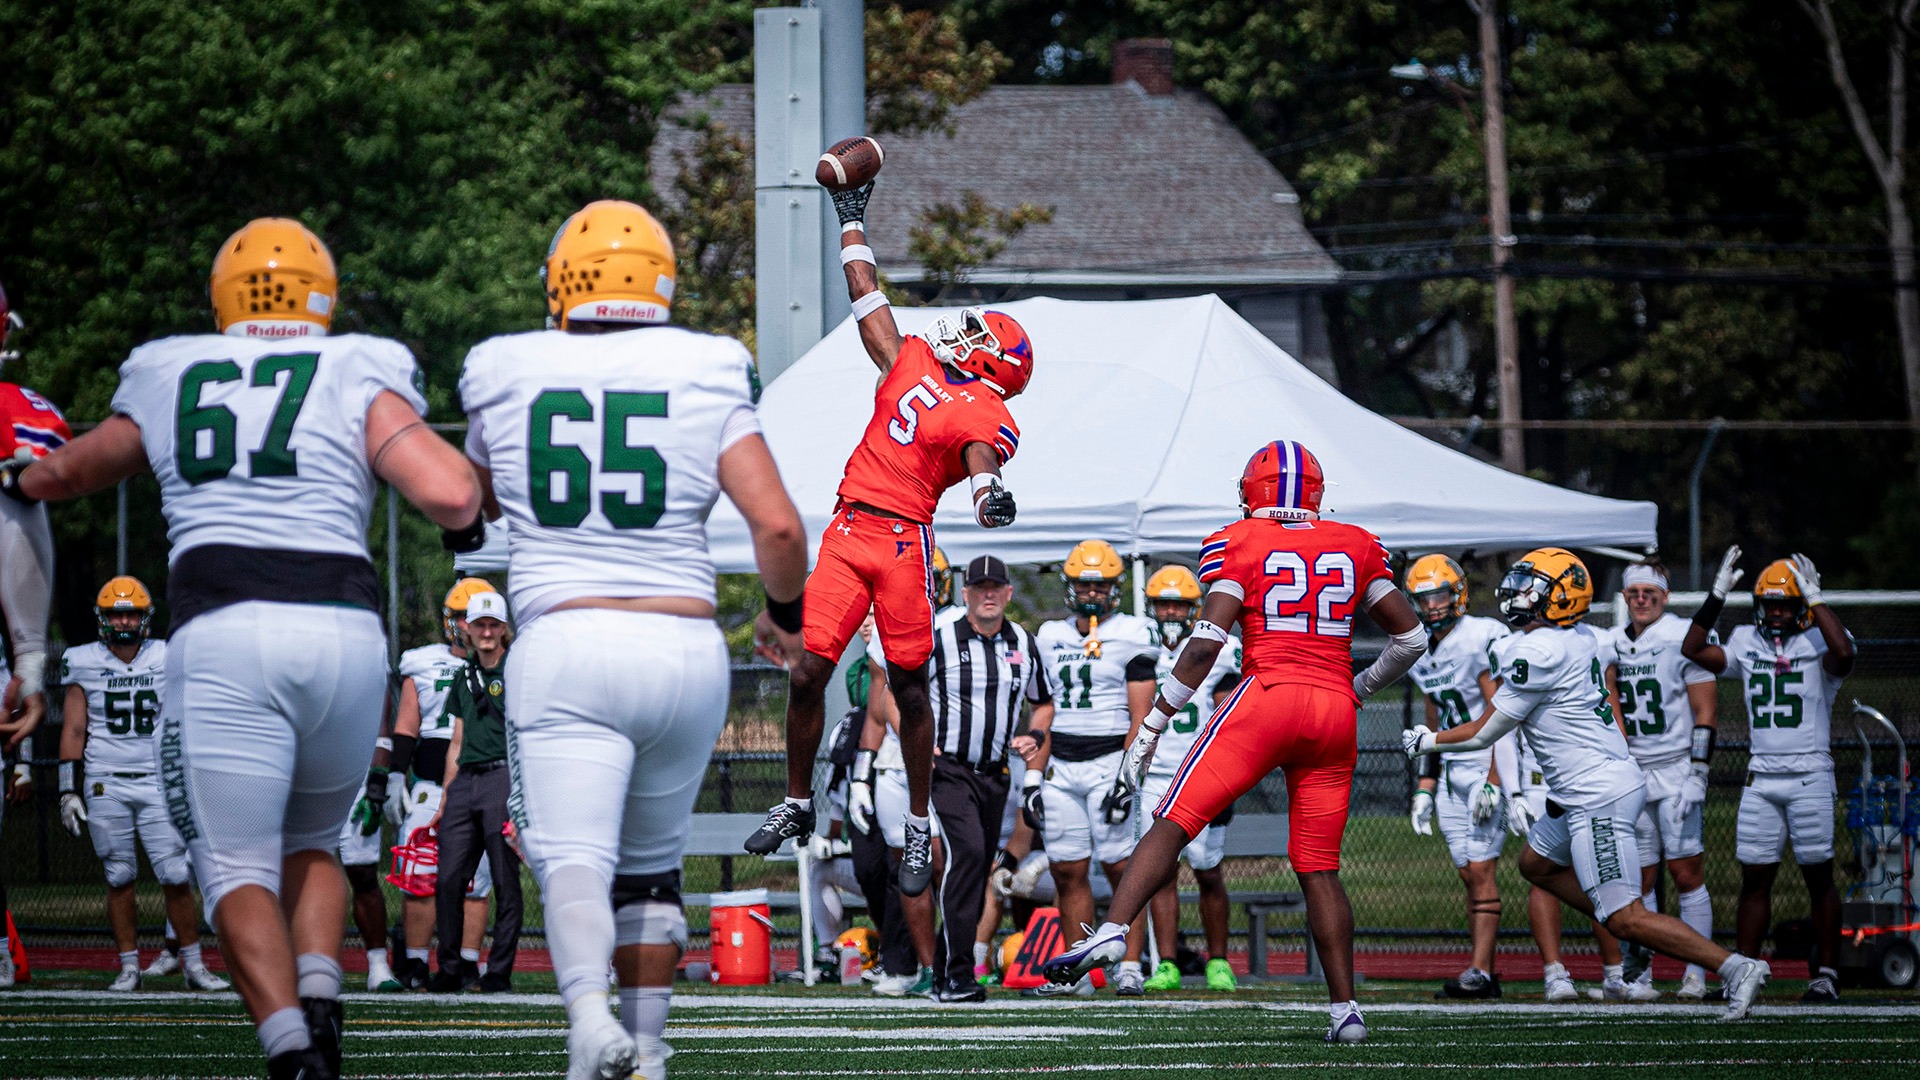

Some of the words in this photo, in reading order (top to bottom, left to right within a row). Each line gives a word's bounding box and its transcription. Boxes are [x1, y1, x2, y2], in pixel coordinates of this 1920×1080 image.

[246, 324, 308, 336] Riddell
[596, 305, 656, 319] Riddell
[888, 383, 940, 446] 5
[921, 374, 954, 403] HOBART
[174, 351, 321, 486] 67
[529, 387, 669, 529] 65
[1268, 510, 1308, 520] HOBART
[1263, 550, 1355, 637] 22
[107, 676, 154, 689] BROCKPORT
[1059, 664, 1093, 708] 11
[1511, 658, 1529, 685] 3
[1590, 656, 1614, 726] 3
[1749, 671, 1804, 729] 25
[104, 689, 159, 737] 56
[1616, 678, 1667, 736] 23
[161, 717, 199, 843] BROCKPORT
[1591, 816, 1622, 884] BROCKPORT
[1014, 915, 1062, 977] 40
